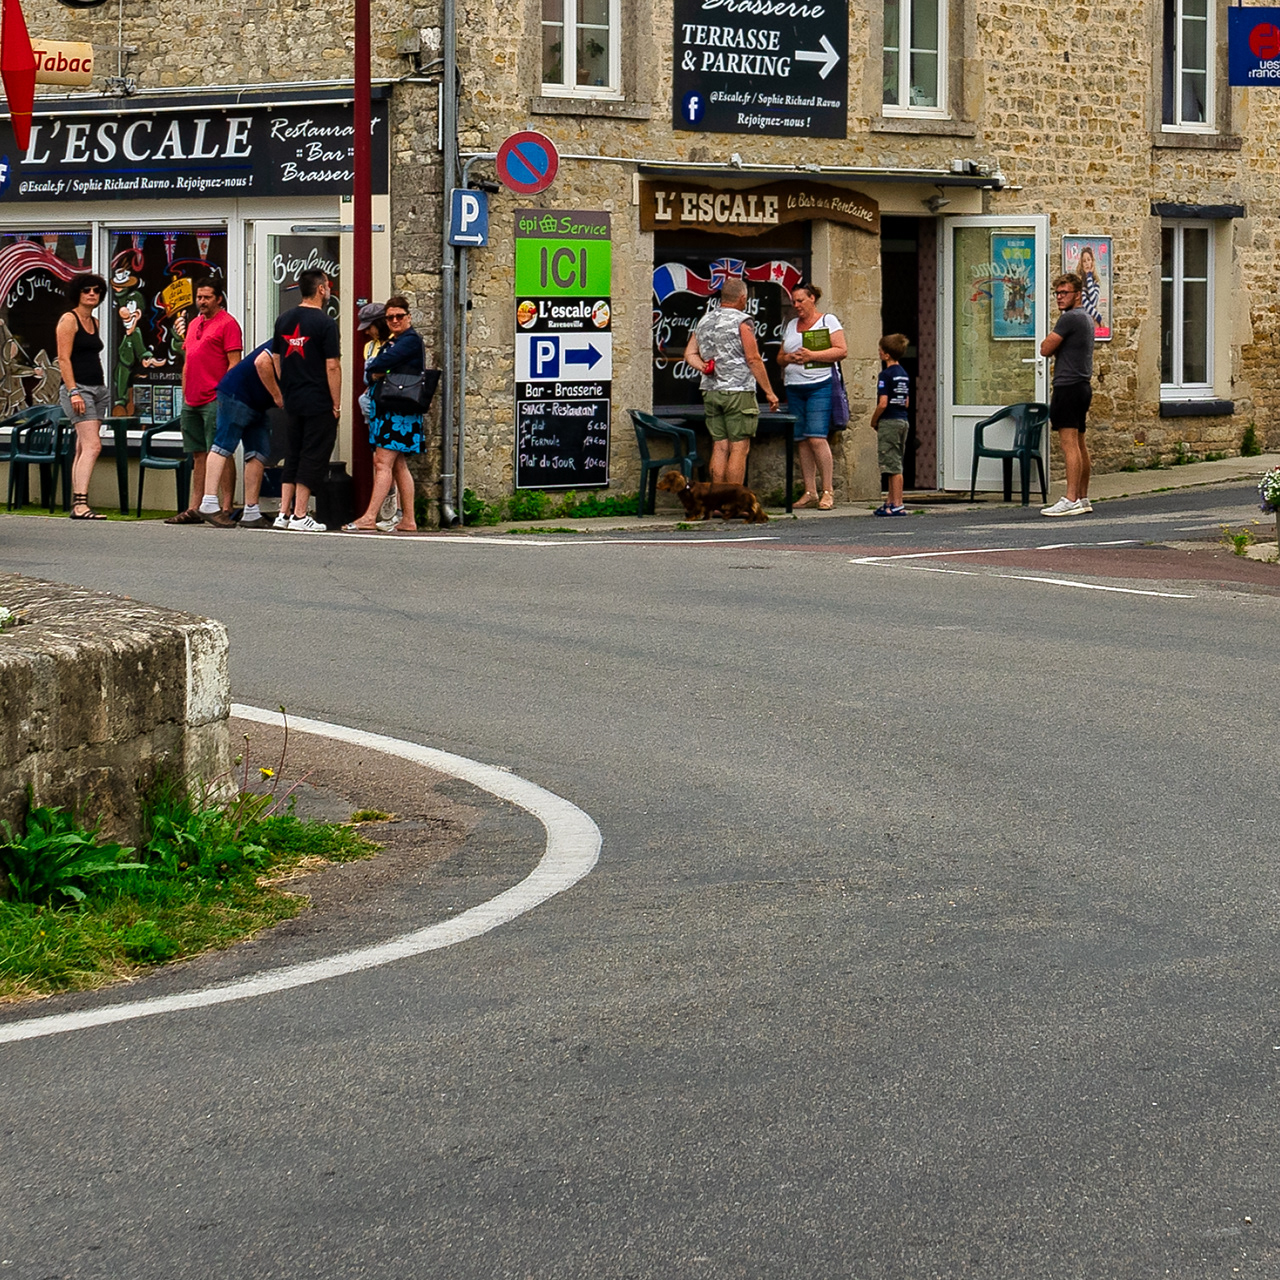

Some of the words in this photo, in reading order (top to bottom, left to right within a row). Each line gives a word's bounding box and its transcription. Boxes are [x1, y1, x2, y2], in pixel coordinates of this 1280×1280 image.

[681, 24, 781, 51] TERRASSE
[33, 51, 92, 73] Tabac
[681, 49, 698, 72] &
[701, 51, 791, 78] PARKING
[709, 91, 751, 106] @Escale.fr
[758, 93, 784, 107] Sophie
[784, 95, 816, 106] Richard
[816, 97, 841, 108] Ravno
[737, 113, 805, 129] Rejoignez-nous
[20, 117, 253, 164] L'ESCALE
[270, 117, 382, 142] Restaurat
[305, 142, 346, 162] Bar
[280, 162, 356, 181] Brasser
[19, 179, 65, 195] @Escale.fr
[72, 179, 102, 194] Sophie
[104, 177, 139, 191] Richard
[140, 177, 170, 189] Ravno
[176, 176, 247, 191] Rejoignez-nous
[460, 194, 480, 232] P
[798, 192, 816, 208] Bar
[831, 197, 874, 222] Fontaine
[519, 215, 538, 234] épi
[558, 216, 607, 235] Service
[540, 246, 587, 289] ICI
[538, 300, 592, 319] L'escale
[547, 320, 584, 329] Ravenoville
[536, 340, 556, 374] P
[525, 383, 545, 397] Bar
[555, 382, 603, 397] Brasserie
